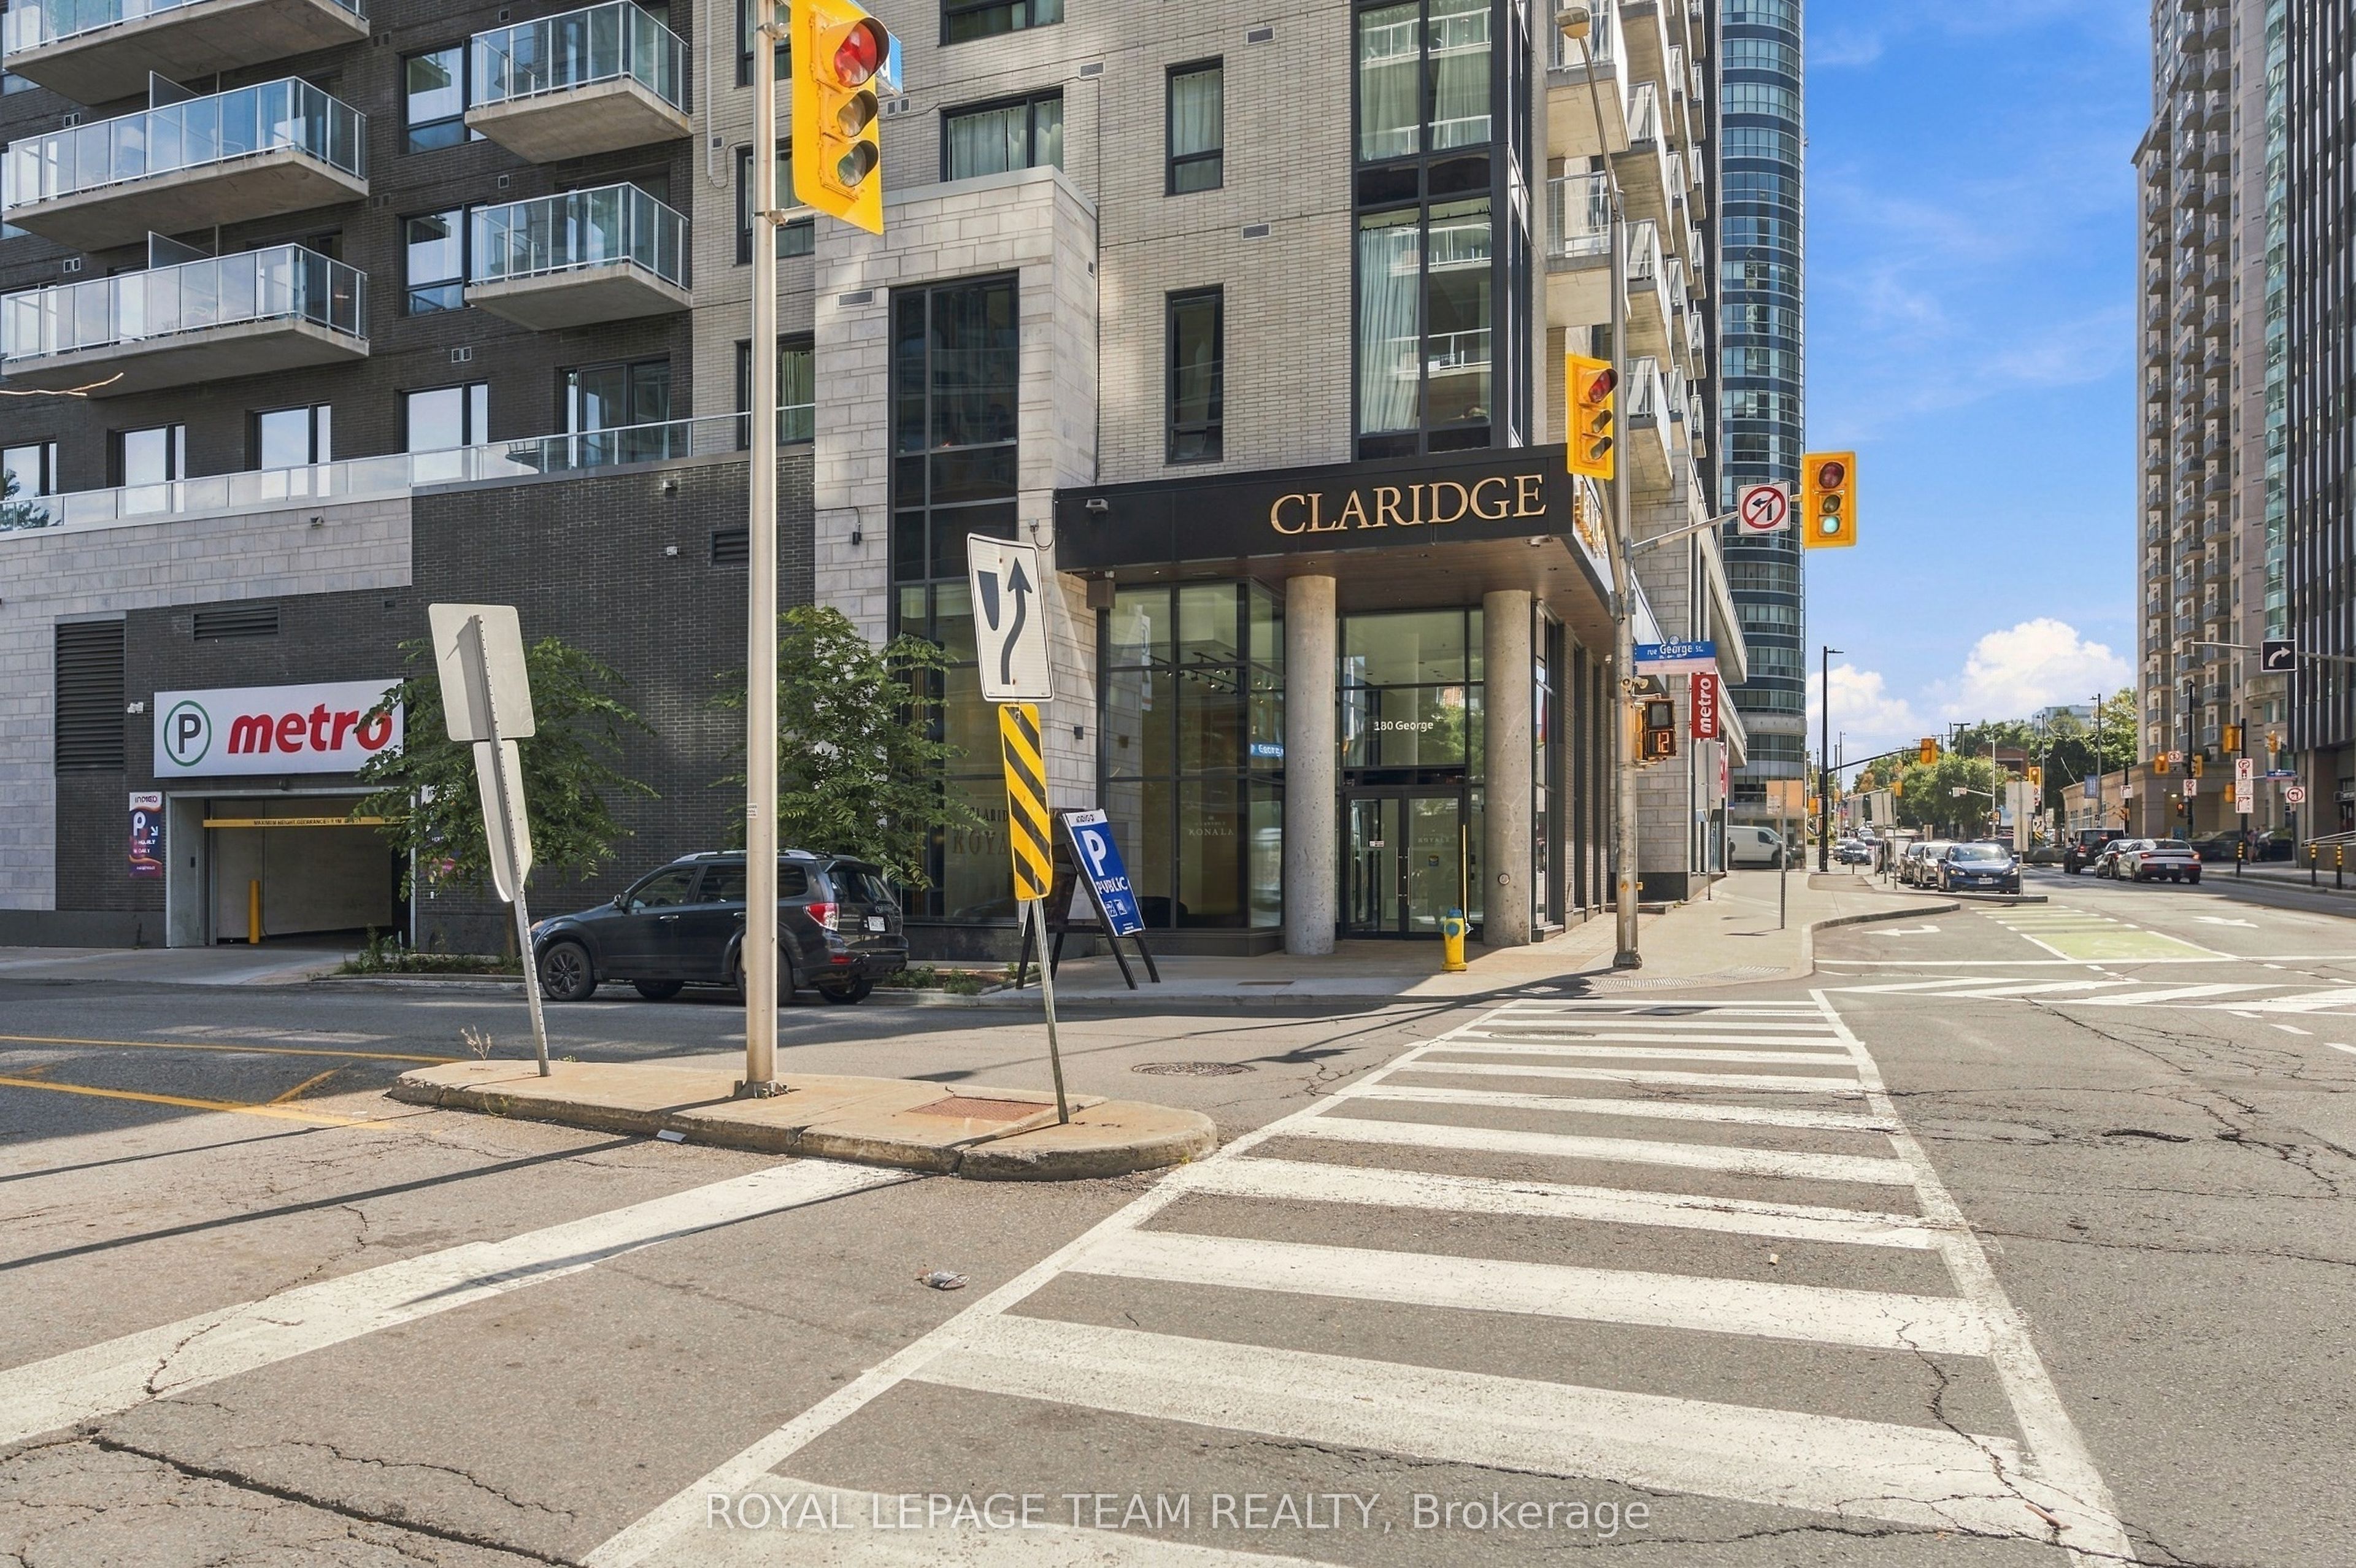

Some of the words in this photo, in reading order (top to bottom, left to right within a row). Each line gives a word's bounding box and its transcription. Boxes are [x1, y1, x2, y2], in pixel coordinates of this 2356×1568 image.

[1271, 474, 1546, 534] CLARIDGE
[1660, 644, 1693, 656] George
[1698, 678, 1712, 734] metro
[179, 713, 201, 754] P
[228, 704, 393, 754] metro
[1374, 721, 1393, 731] 180
[1395, 720, 1434, 732] George
[133, 811, 147, 836] P
[969, 807, 1009, 821] CLARID
[953, 828, 1009, 855] ROYA
[1081, 829, 1106, 877] P
[1095, 876, 1128, 894] PUBLIC
